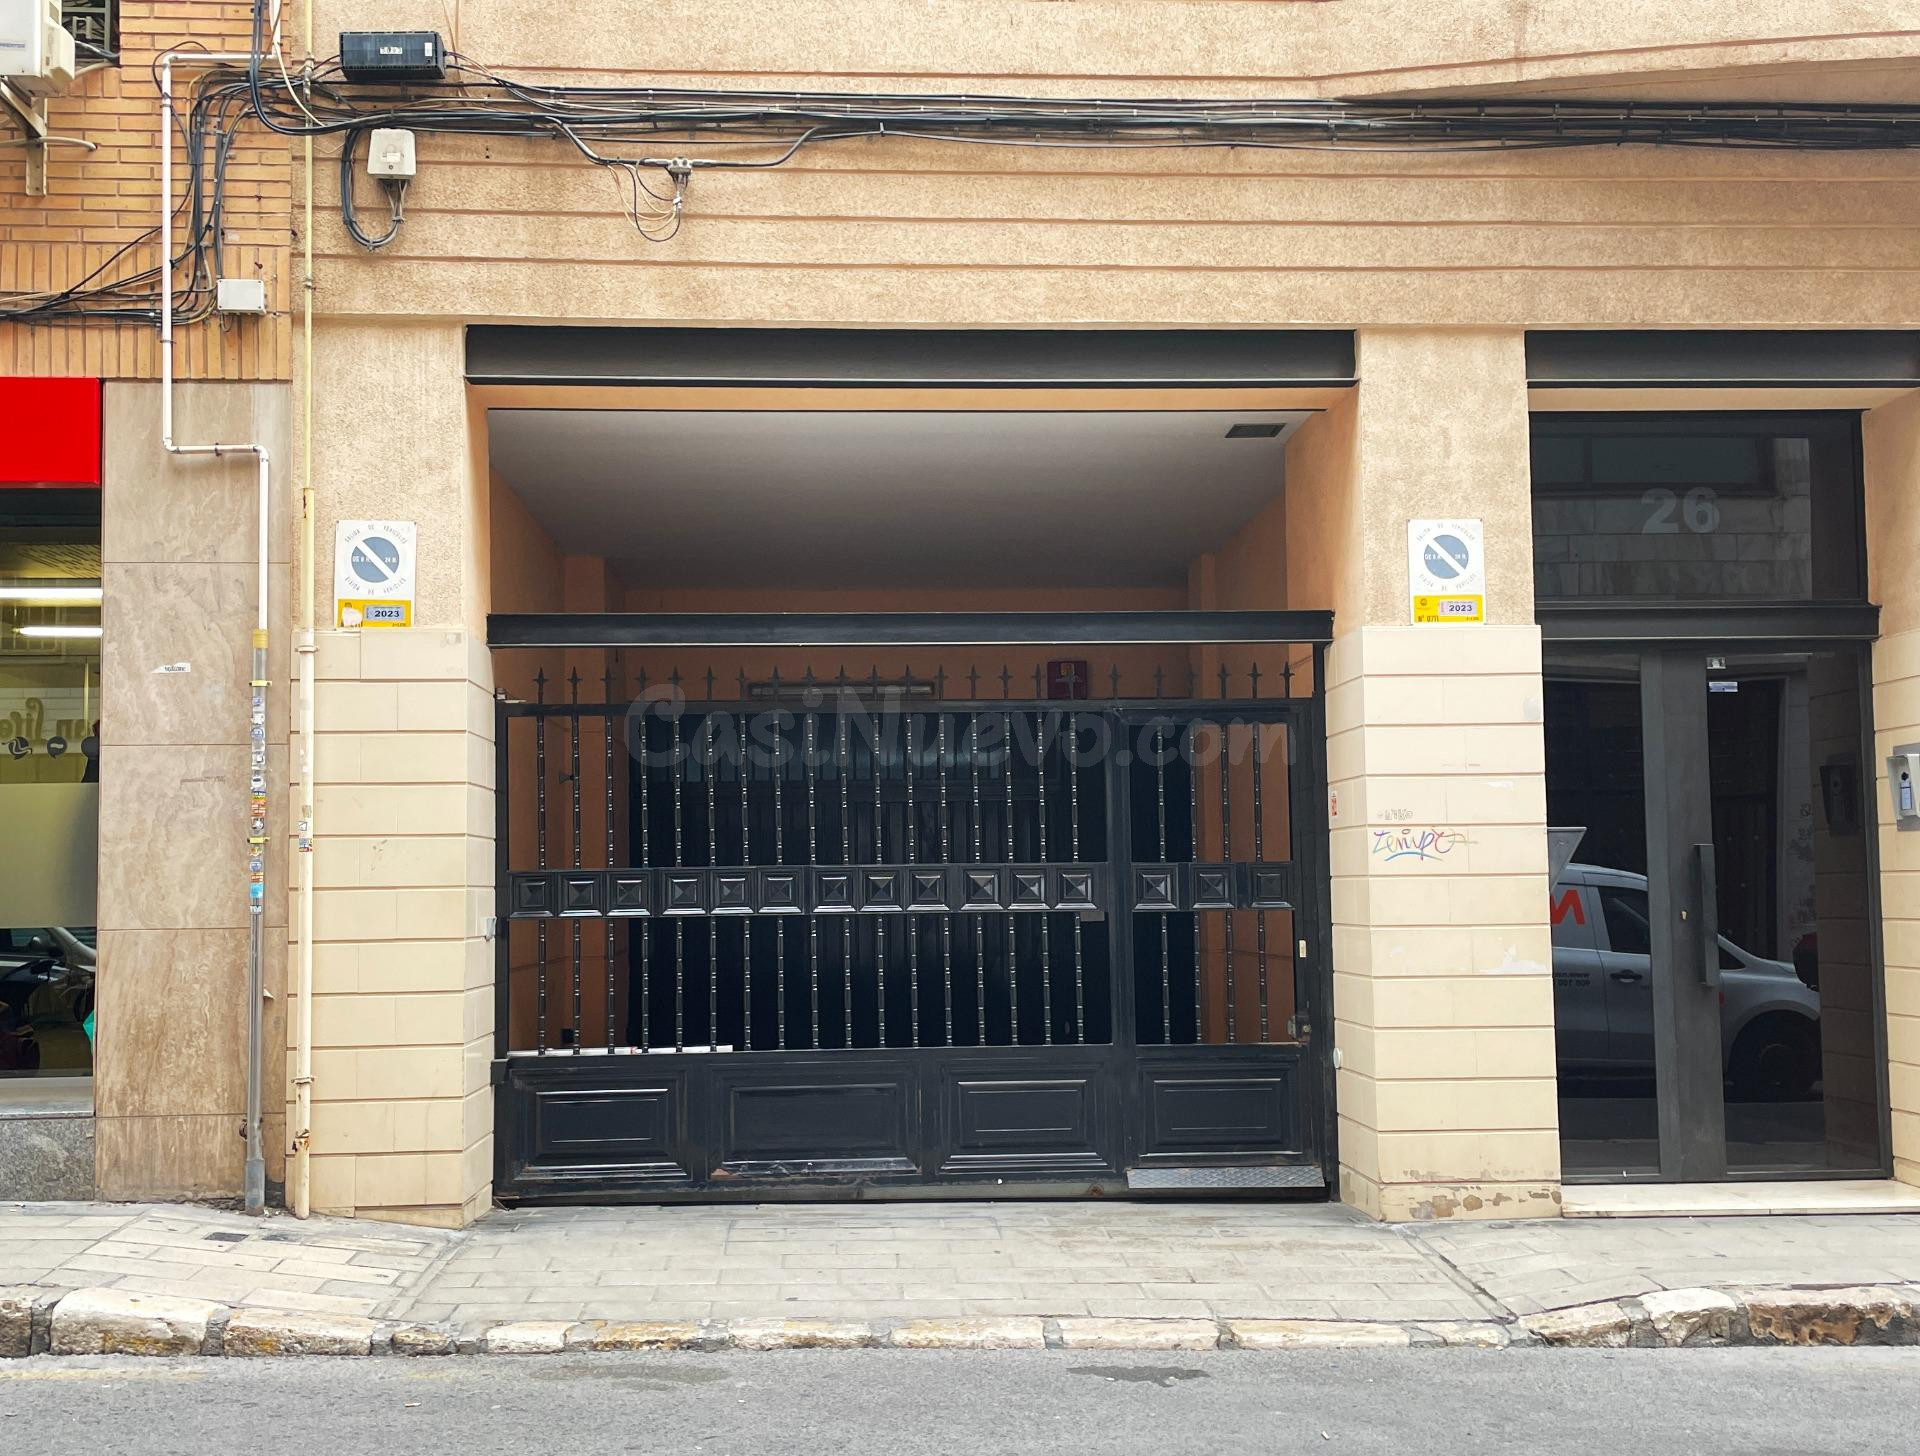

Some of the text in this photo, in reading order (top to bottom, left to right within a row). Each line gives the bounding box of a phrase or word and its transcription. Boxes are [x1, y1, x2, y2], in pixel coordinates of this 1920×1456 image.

[1640, 486, 1720, 534] 26
[1448, 604, 1473, 612] 2023
[374, 610, 400, 618] 2023
